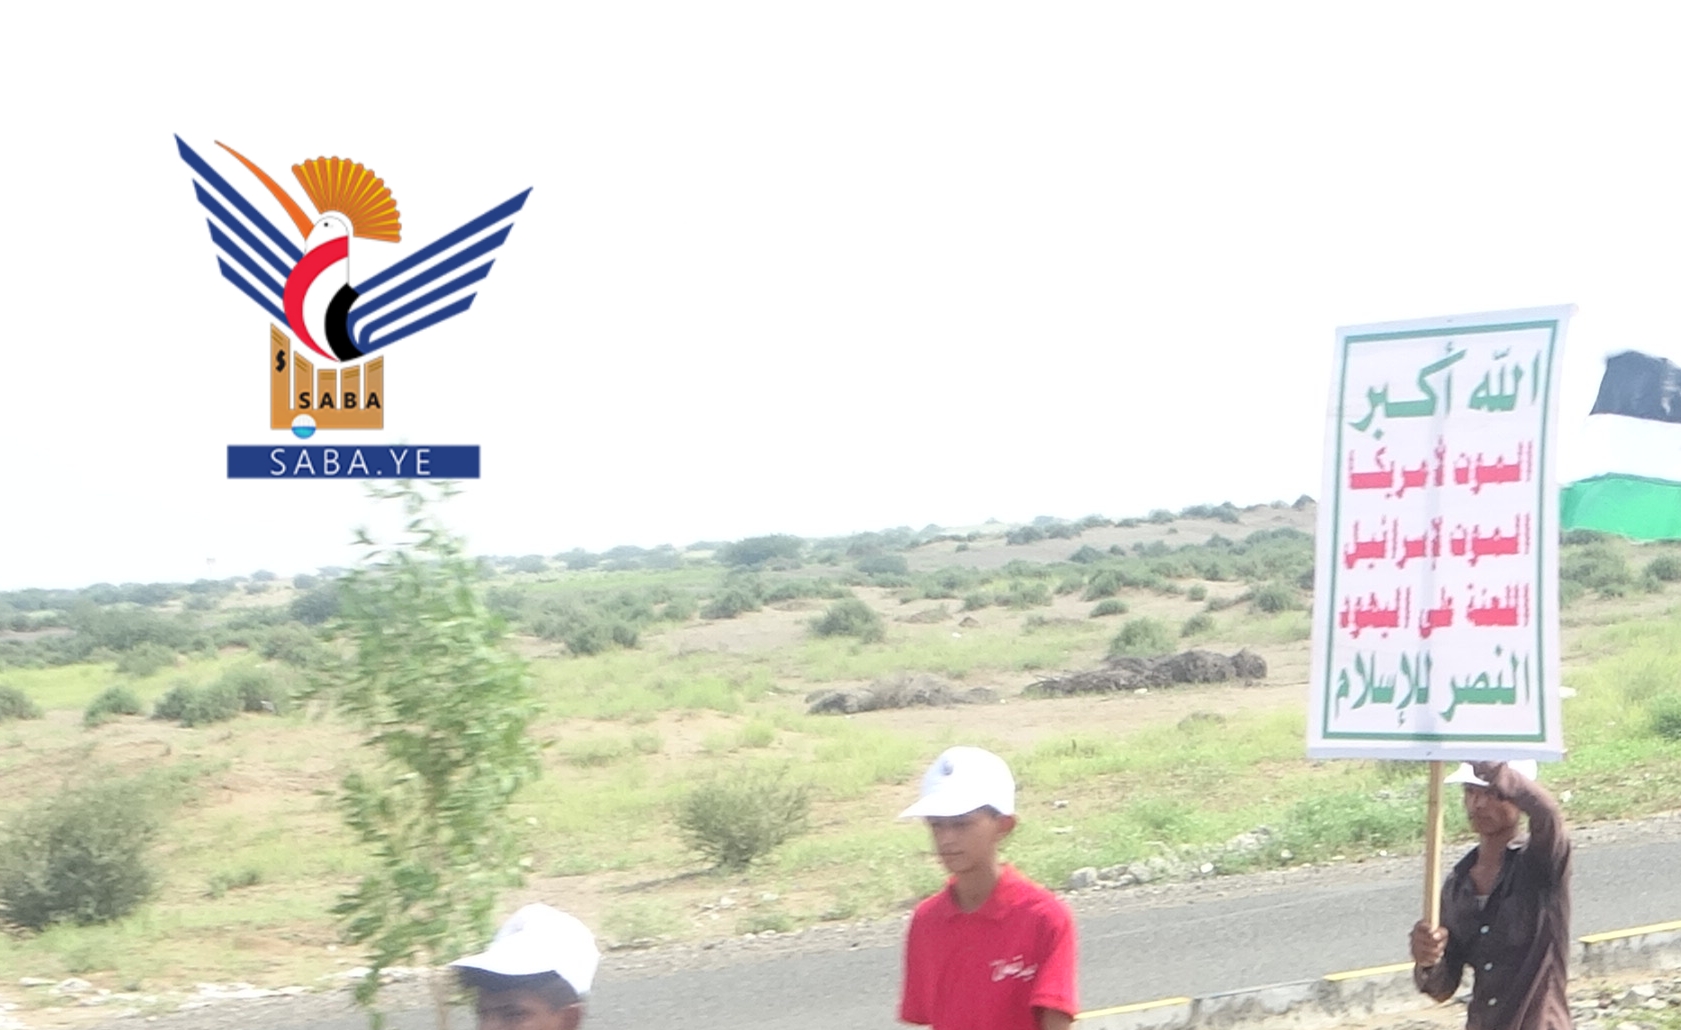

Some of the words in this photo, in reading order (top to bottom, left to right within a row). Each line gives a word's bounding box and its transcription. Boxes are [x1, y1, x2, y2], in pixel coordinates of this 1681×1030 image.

[1348, 341, 1467, 440] أكبر
[1348, 435, 1446, 499] لأمريكا
[1453, 440, 1533, 495] الموت
[1344, 516, 1443, 570] لإسرائيل
[1449, 512, 1530, 567] الموت
[1339, 586, 1410, 639] اليهود
[1419, 587, 1454, 639] على
[1466, 583, 1529, 627] اللعنة
[1334, 650, 1432, 727] للإسلام
[1439, 645, 1529, 722] النصر
